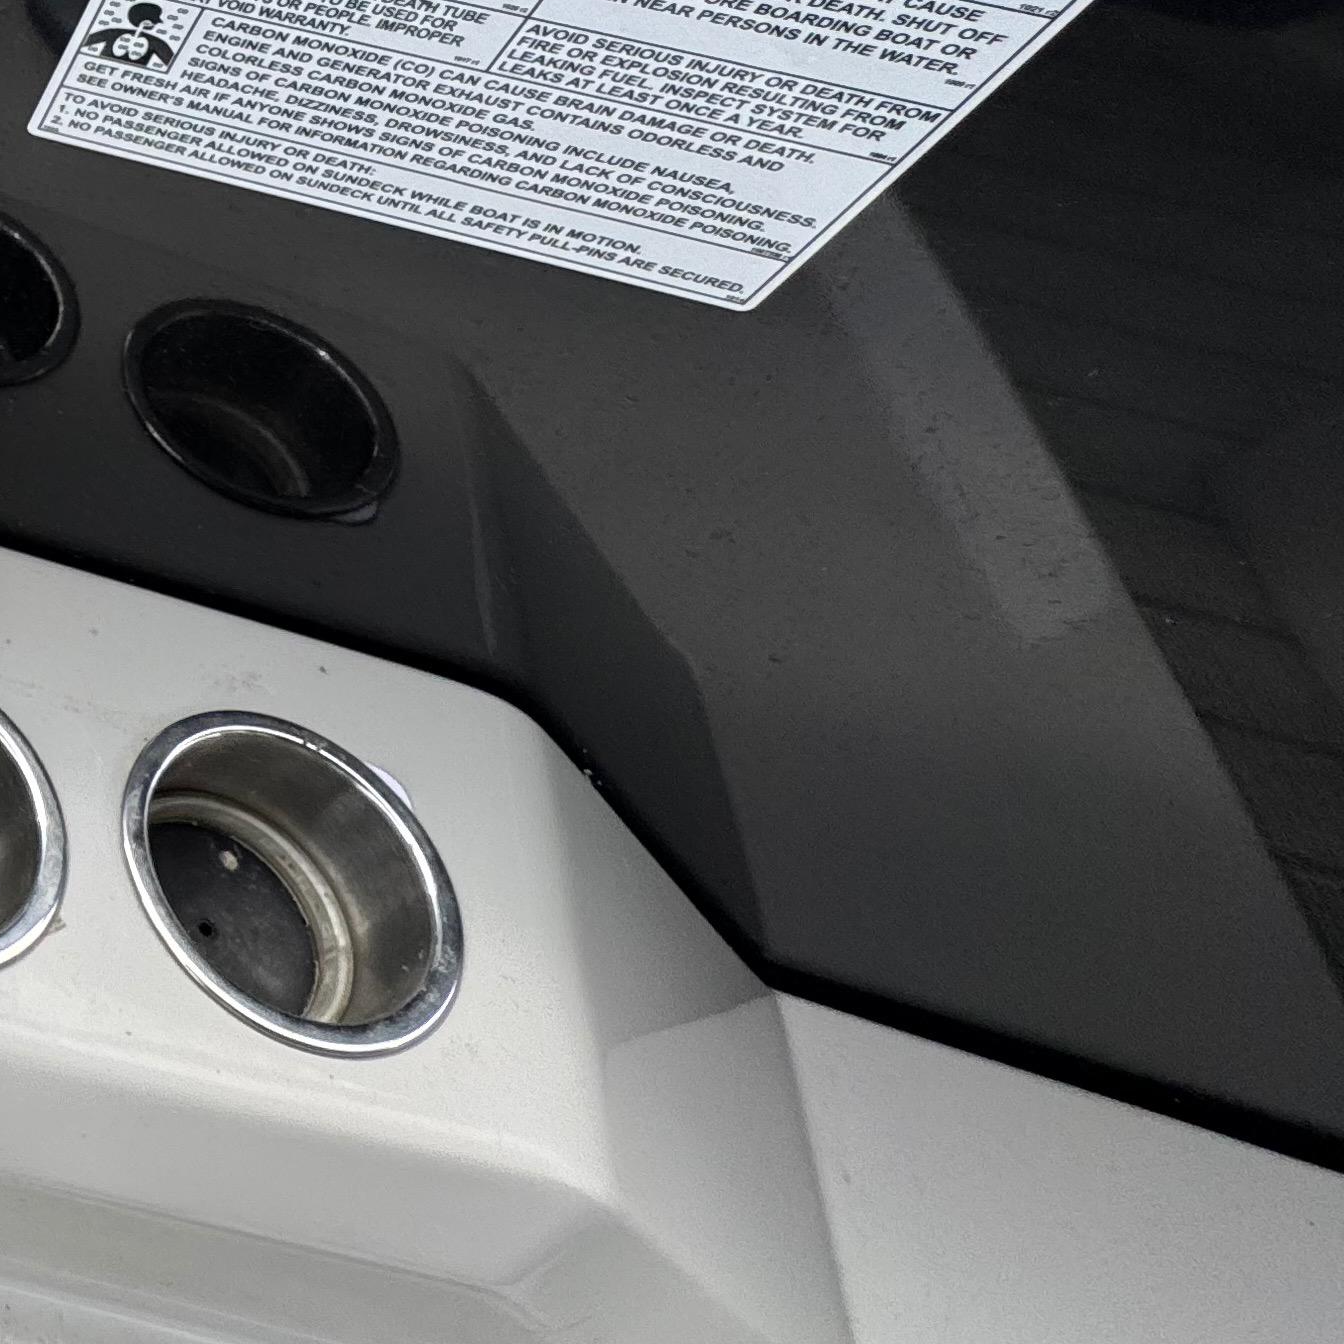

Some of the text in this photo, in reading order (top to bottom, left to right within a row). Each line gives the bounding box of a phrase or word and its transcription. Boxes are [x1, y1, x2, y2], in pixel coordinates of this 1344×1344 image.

[443, 5, 490, 24] TUBE
[891, 14, 958, 35] SHUT
[958, 28, 1009, 45] OFF
[211, 17, 815, 164] CARBON MONOXIDE (CO) CAN CAUSE BRAIN DAMAGE OR DEATH.
[526, 24, 942, 123] AVOID SERIOUS INJURY OR DEATH FROM
